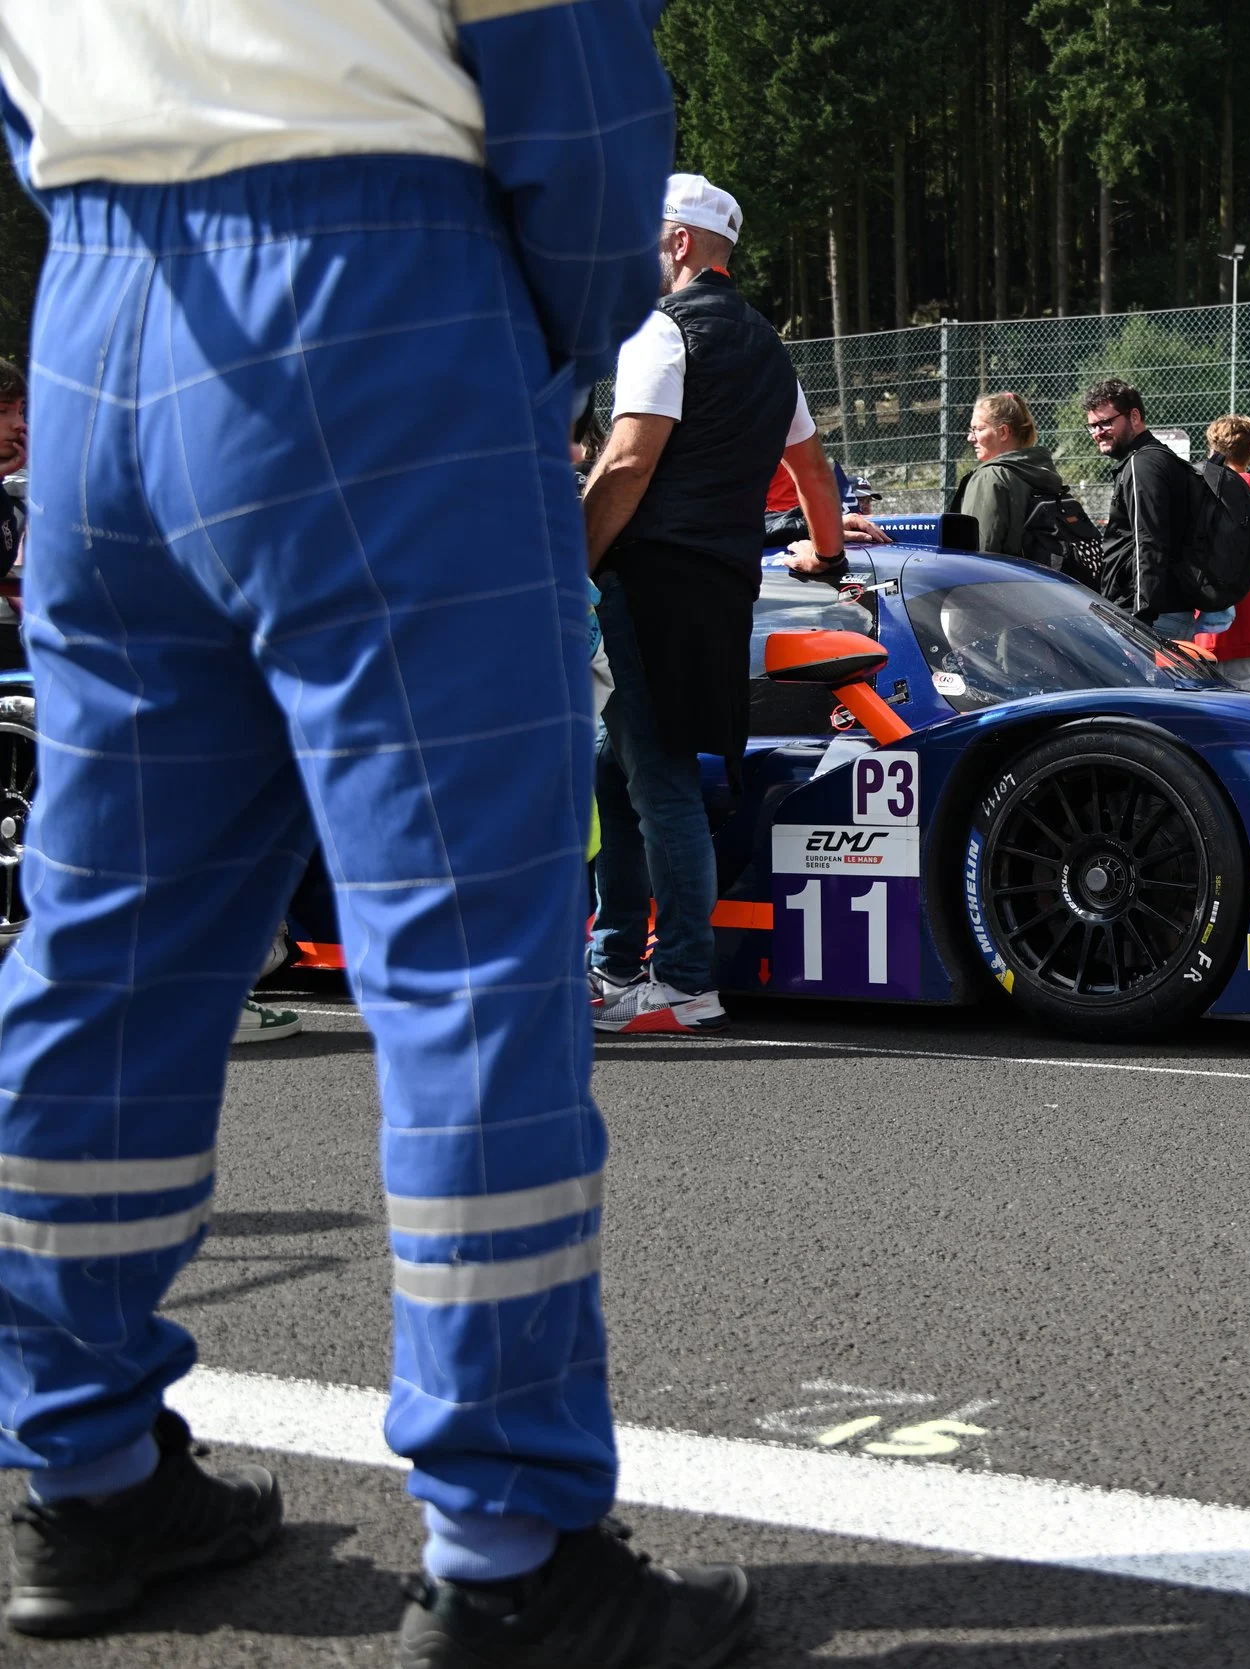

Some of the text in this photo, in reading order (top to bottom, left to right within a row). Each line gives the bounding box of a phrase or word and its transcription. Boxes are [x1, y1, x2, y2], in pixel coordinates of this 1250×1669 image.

[857, 759, 915, 817] P3
[805, 855, 842, 863] EUROPEAN
[858, 856, 879, 864] MANS
[966, 840, 993, 954] MICHELIN
[786, 879, 888, 984] 11
